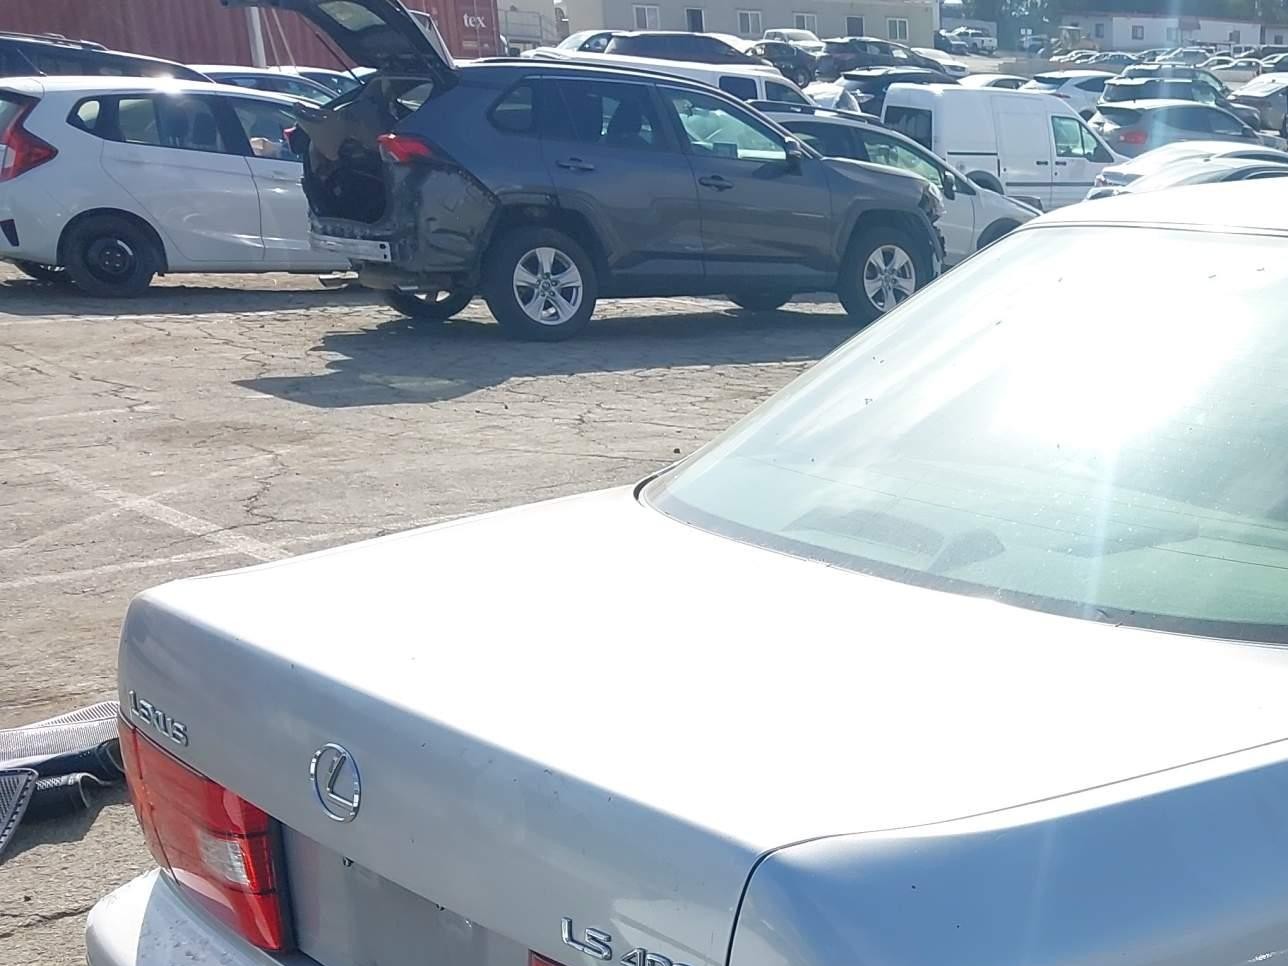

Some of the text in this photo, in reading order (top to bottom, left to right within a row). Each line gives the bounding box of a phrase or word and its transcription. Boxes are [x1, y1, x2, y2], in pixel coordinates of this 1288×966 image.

[463, 13, 486, 28] tex
[128, 690, 189, 747] LEXUS
[560, 917, 612, 960] LS
